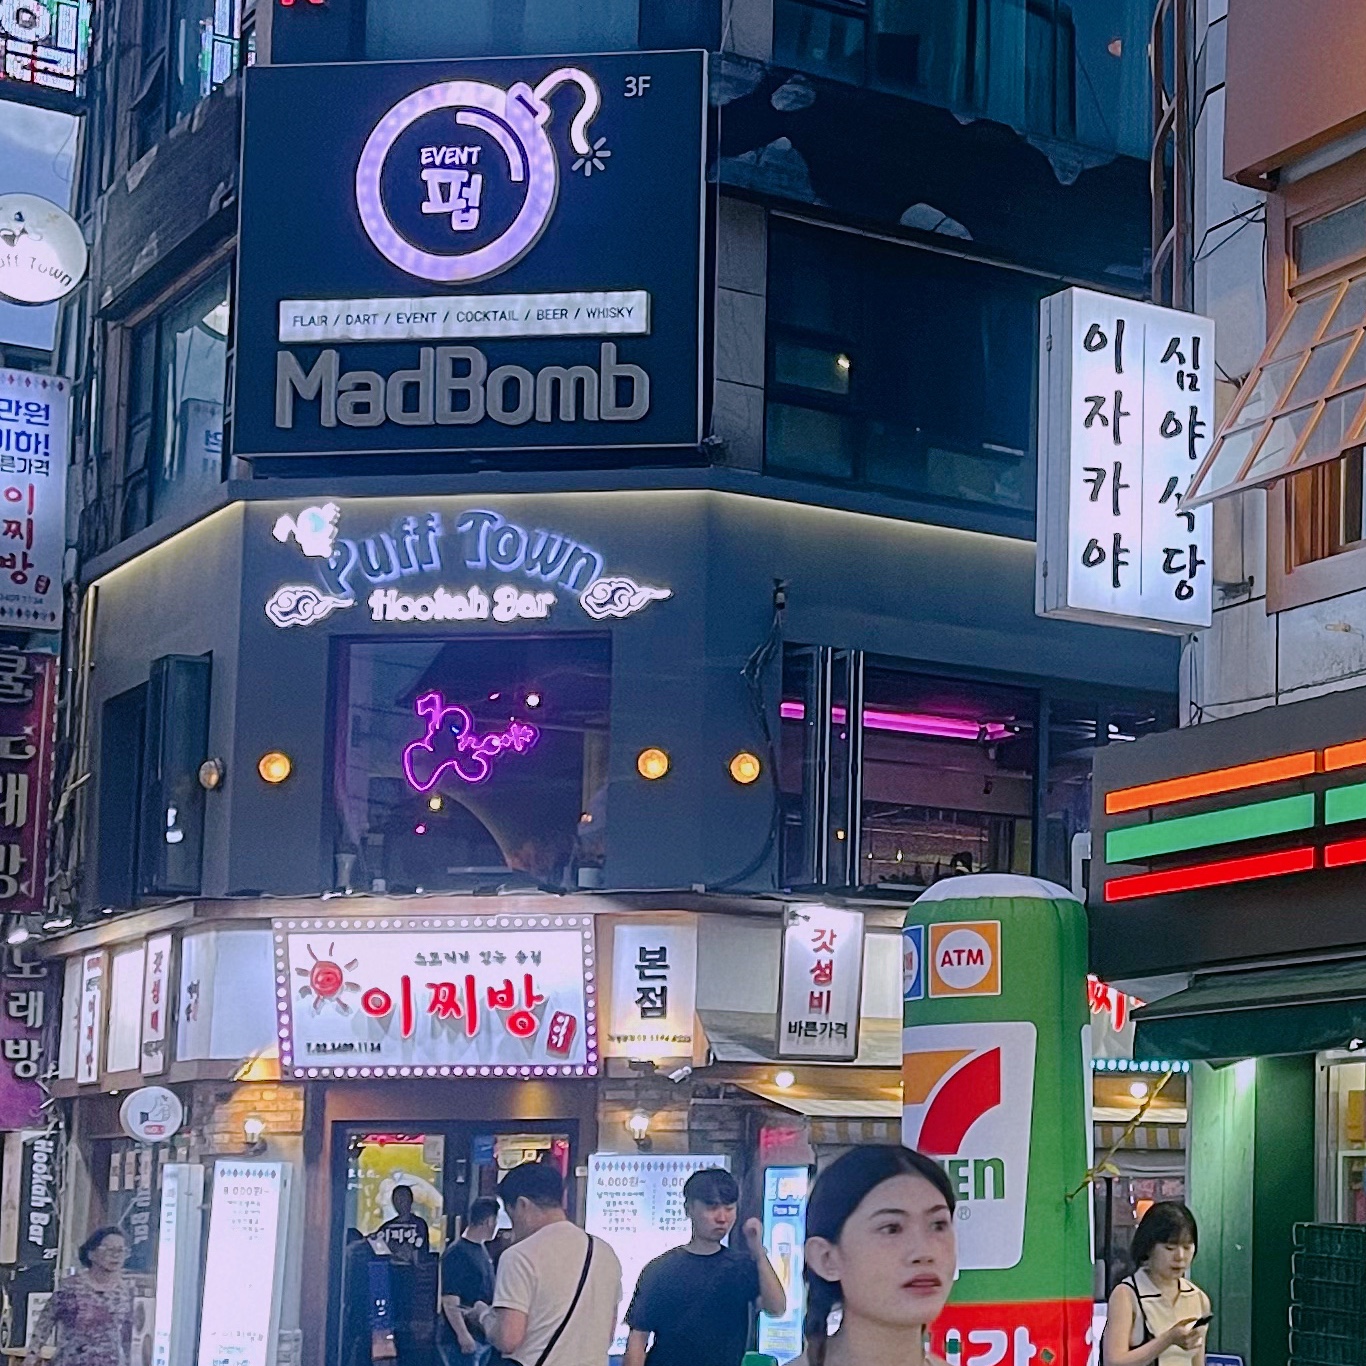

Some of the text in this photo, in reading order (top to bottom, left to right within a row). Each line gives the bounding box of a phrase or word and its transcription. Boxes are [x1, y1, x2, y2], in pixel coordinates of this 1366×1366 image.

[624, 75, 651, 98] 3F
[420, 146, 481, 166] EVENT
[30, 255, 72, 287] Town
[292, 313, 329, 328] FLAIR
[345, 312, 379, 327] DART
[396, 311, 438, 325] EVENT
[456, 308, 520, 324] COCKTAIL
[536, 307, 569, 321] BEER
[585, 305, 635, 320] WHISKY
[275, 341, 650, 429] MadBomb
[1081, 317, 1130, 589] 이자카야
[456, 508, 605, 595] Town
[367, 585, 558, 622] Hookah Bar
[634, 945, 671, 1020] 본점
[808, 927, 838, 1015] 갓성비
[940, 948, 985, 968] ATM
[5, 944, 48, 1079] 노래방
[360, 972, 546, 1039] 이찌방
[788, 1020, 849, 1039] 바른가격
[28, 1138, 54, 1246] Hookah Bar
